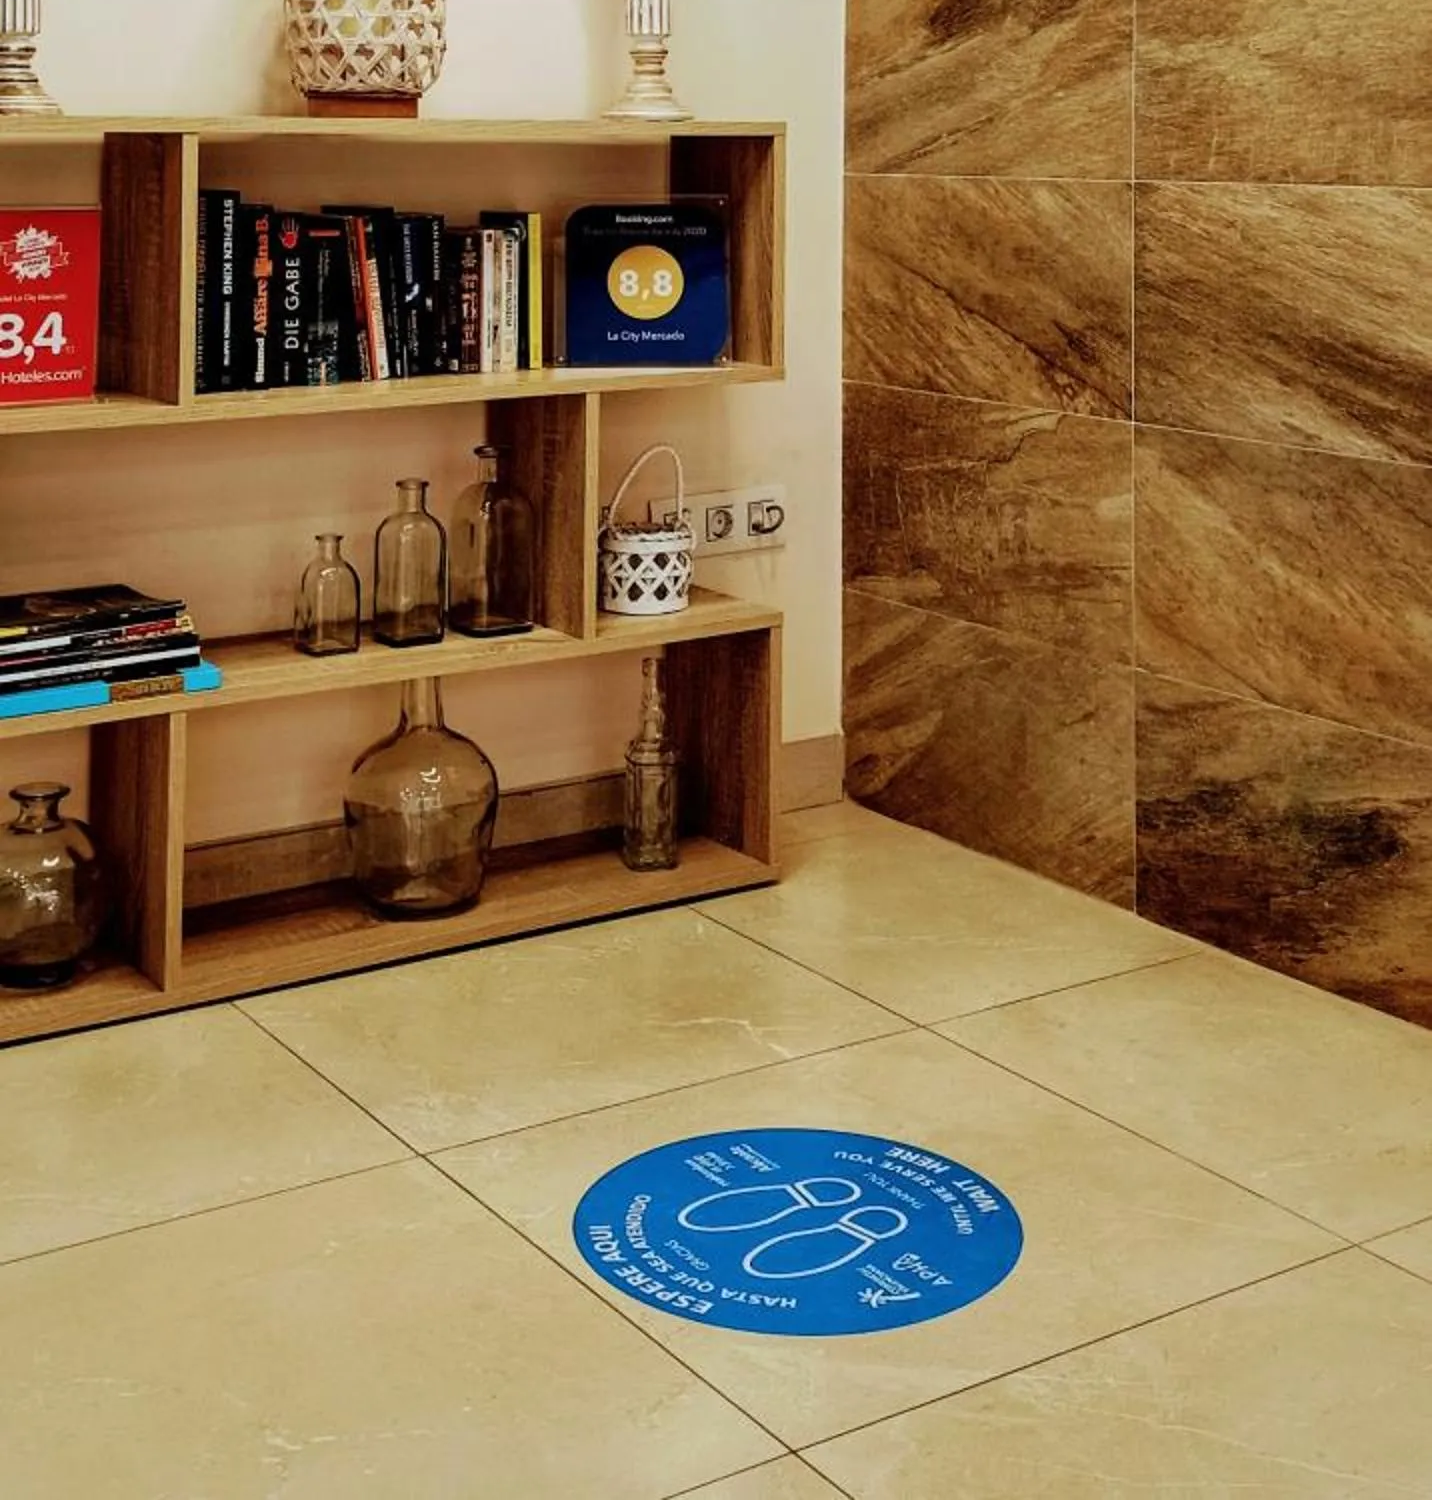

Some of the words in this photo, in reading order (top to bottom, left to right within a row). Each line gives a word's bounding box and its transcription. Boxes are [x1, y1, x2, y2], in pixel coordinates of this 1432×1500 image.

[223, 199, 234, 259] STEPHEN
[223, 262, 233, 295] KING
[284, 257, 300, 311] GABE
[619, 269, 673, 301] 8,8
[0, 312, 67, 364] 8,4
[284, 318, 300, 349] DIE
[607, 331, 619, 341] La
[621, 330, 641, 343] City
[641, 330, 685, 341] Mercado
[1, 368, 84, 385] Hoteles.com
[833, 1150, 874, 1166] YOU
[884, 1146, 951, 1174] HERE
[880, 1161, 936, 1188] SERVE
[930, 1185, 958, 1204] WE
[952, 1179, 1000, 1213] WAIT
[625, 1194, 652, 1250] ATENDIDO
[951, 1203, 974, 1236] UNTIL
[588, 1224, 628, 1262] AQUI
[663, 1239, 711, 1271] GRACIAS
[640, 1250, 675, 1273] SEA
[612, 1264, 715, 1315] ESPERE
[668, 1271, 715, 1293] QUE
[720, 1287, 797, 1309] HASTA
